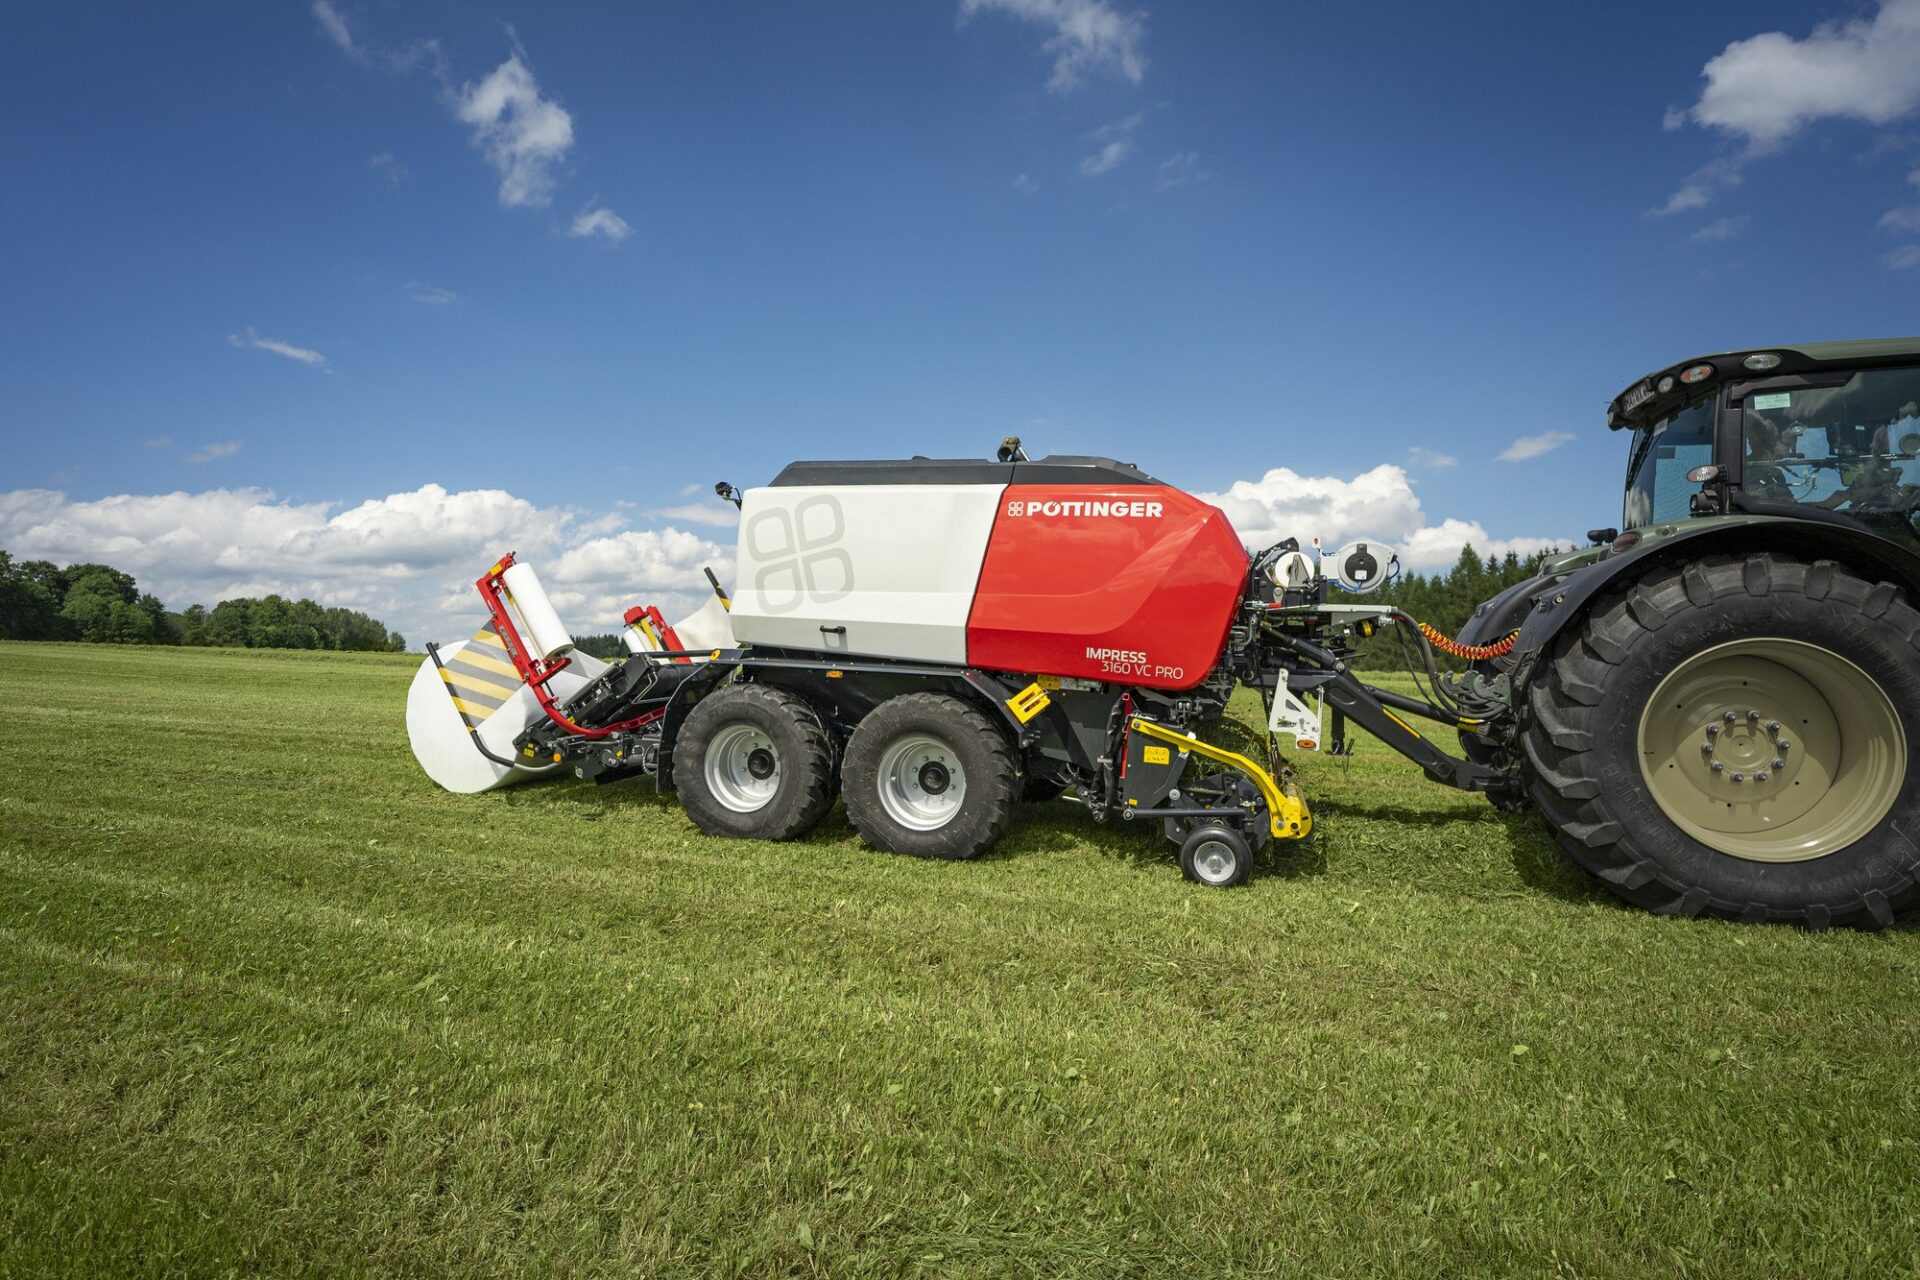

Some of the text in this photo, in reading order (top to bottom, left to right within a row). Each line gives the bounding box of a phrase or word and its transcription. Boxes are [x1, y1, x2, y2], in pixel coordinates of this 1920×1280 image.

[1026, 500, 1163, 518] PÖTTINGER
[1086, 647, 1147, 664] IMPRESS
[1101, 660, 1184, 680] 3160 VC PRO
